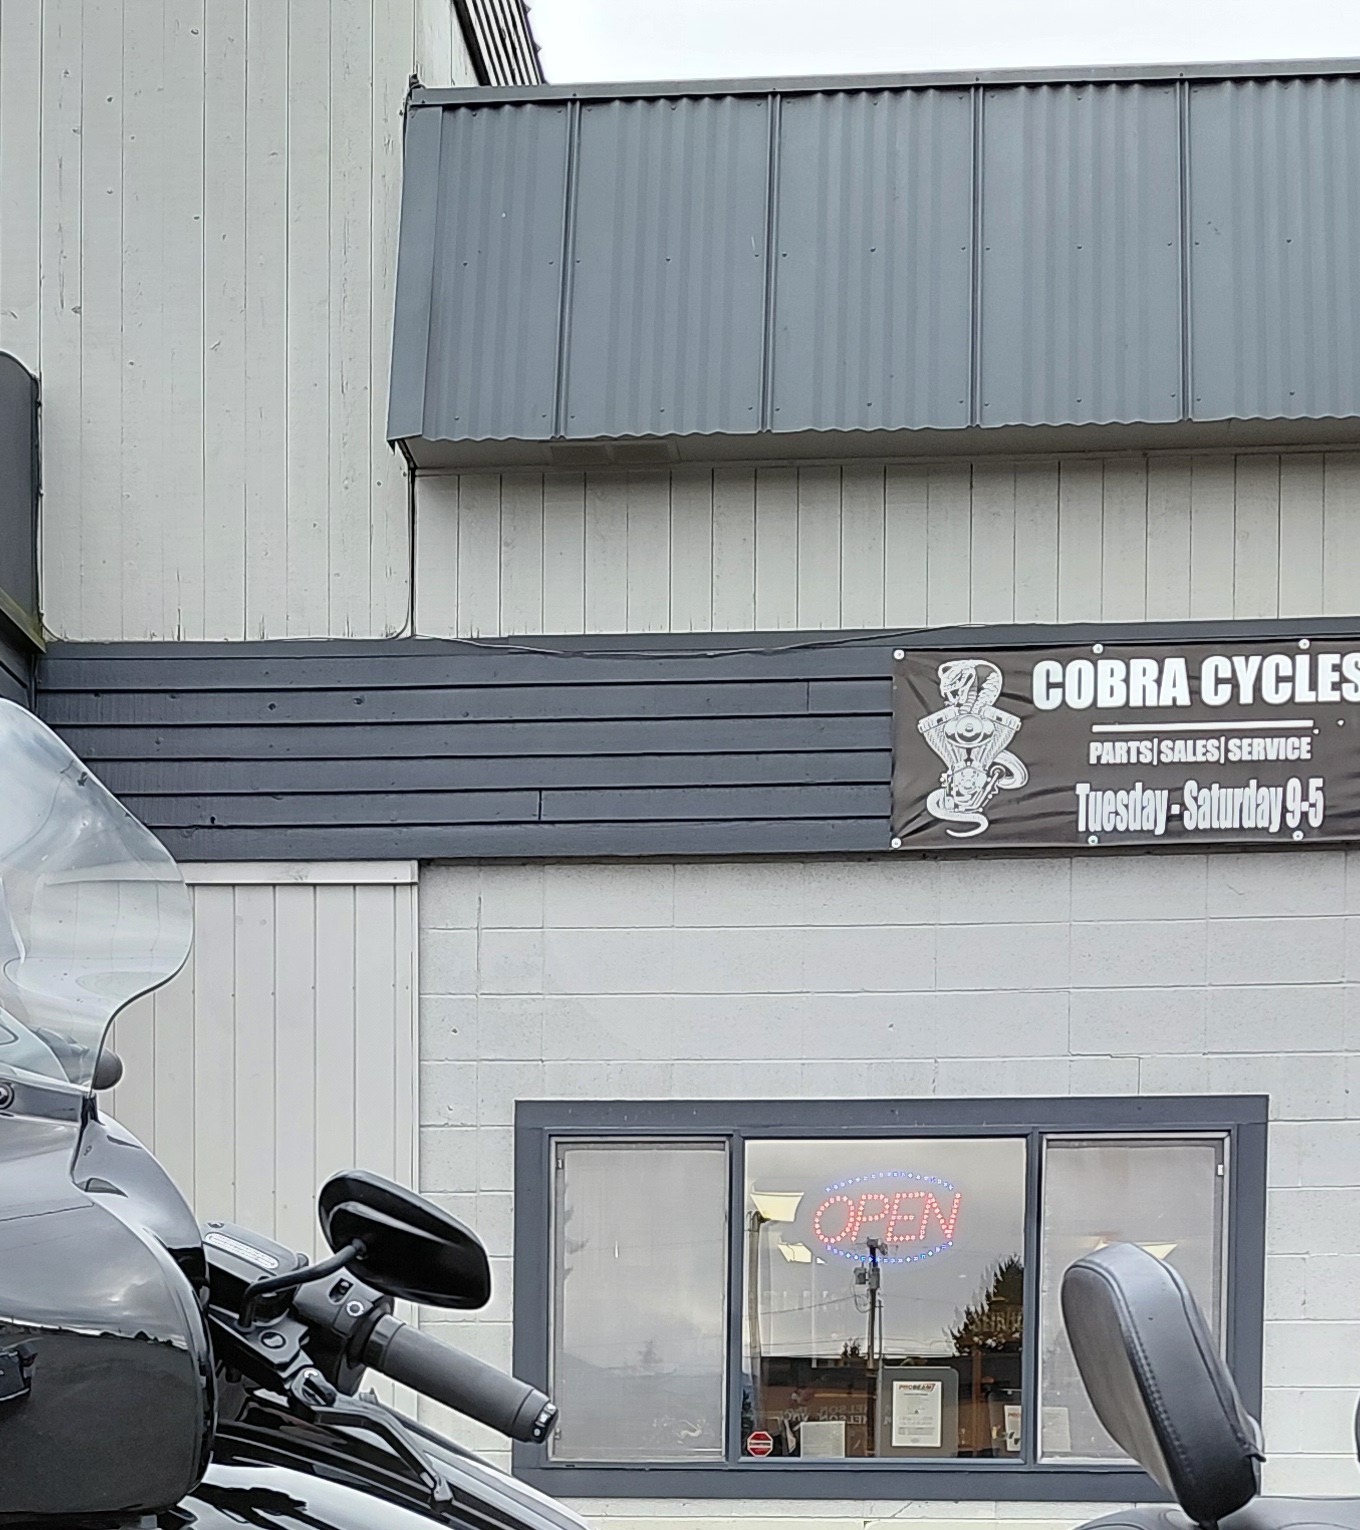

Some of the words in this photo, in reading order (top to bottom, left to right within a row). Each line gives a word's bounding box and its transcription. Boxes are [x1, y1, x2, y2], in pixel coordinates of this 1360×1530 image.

[1031, 656, 1191, 711] COBRA
[1074, 782, 1169, 835] Tuesday
[1182, 779, 1281, 834] Saturday
[1286, 777, 1325, 829] 9-5
[814, 1191, 963, 1244] OPEN
